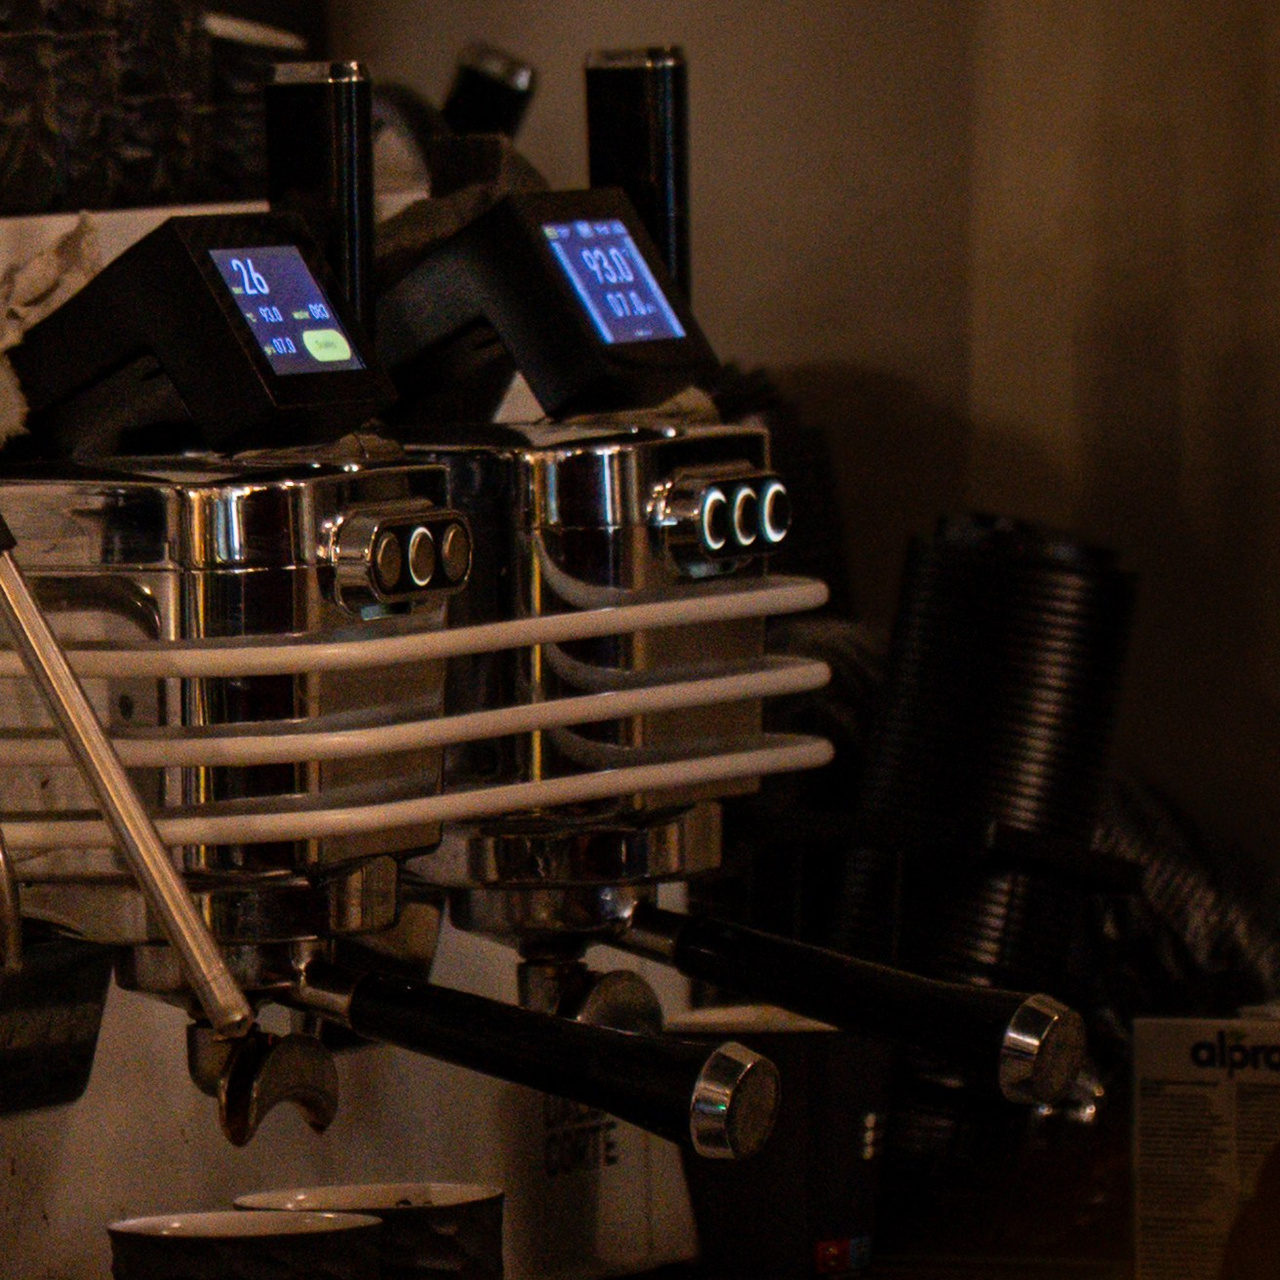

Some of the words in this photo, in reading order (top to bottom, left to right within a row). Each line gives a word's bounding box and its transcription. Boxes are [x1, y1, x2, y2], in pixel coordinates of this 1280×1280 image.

[231, 258, 269, 295] 26
[581, 247, 634, 284] 93.0
[1192, 1030, 1280, 1078] alpro
